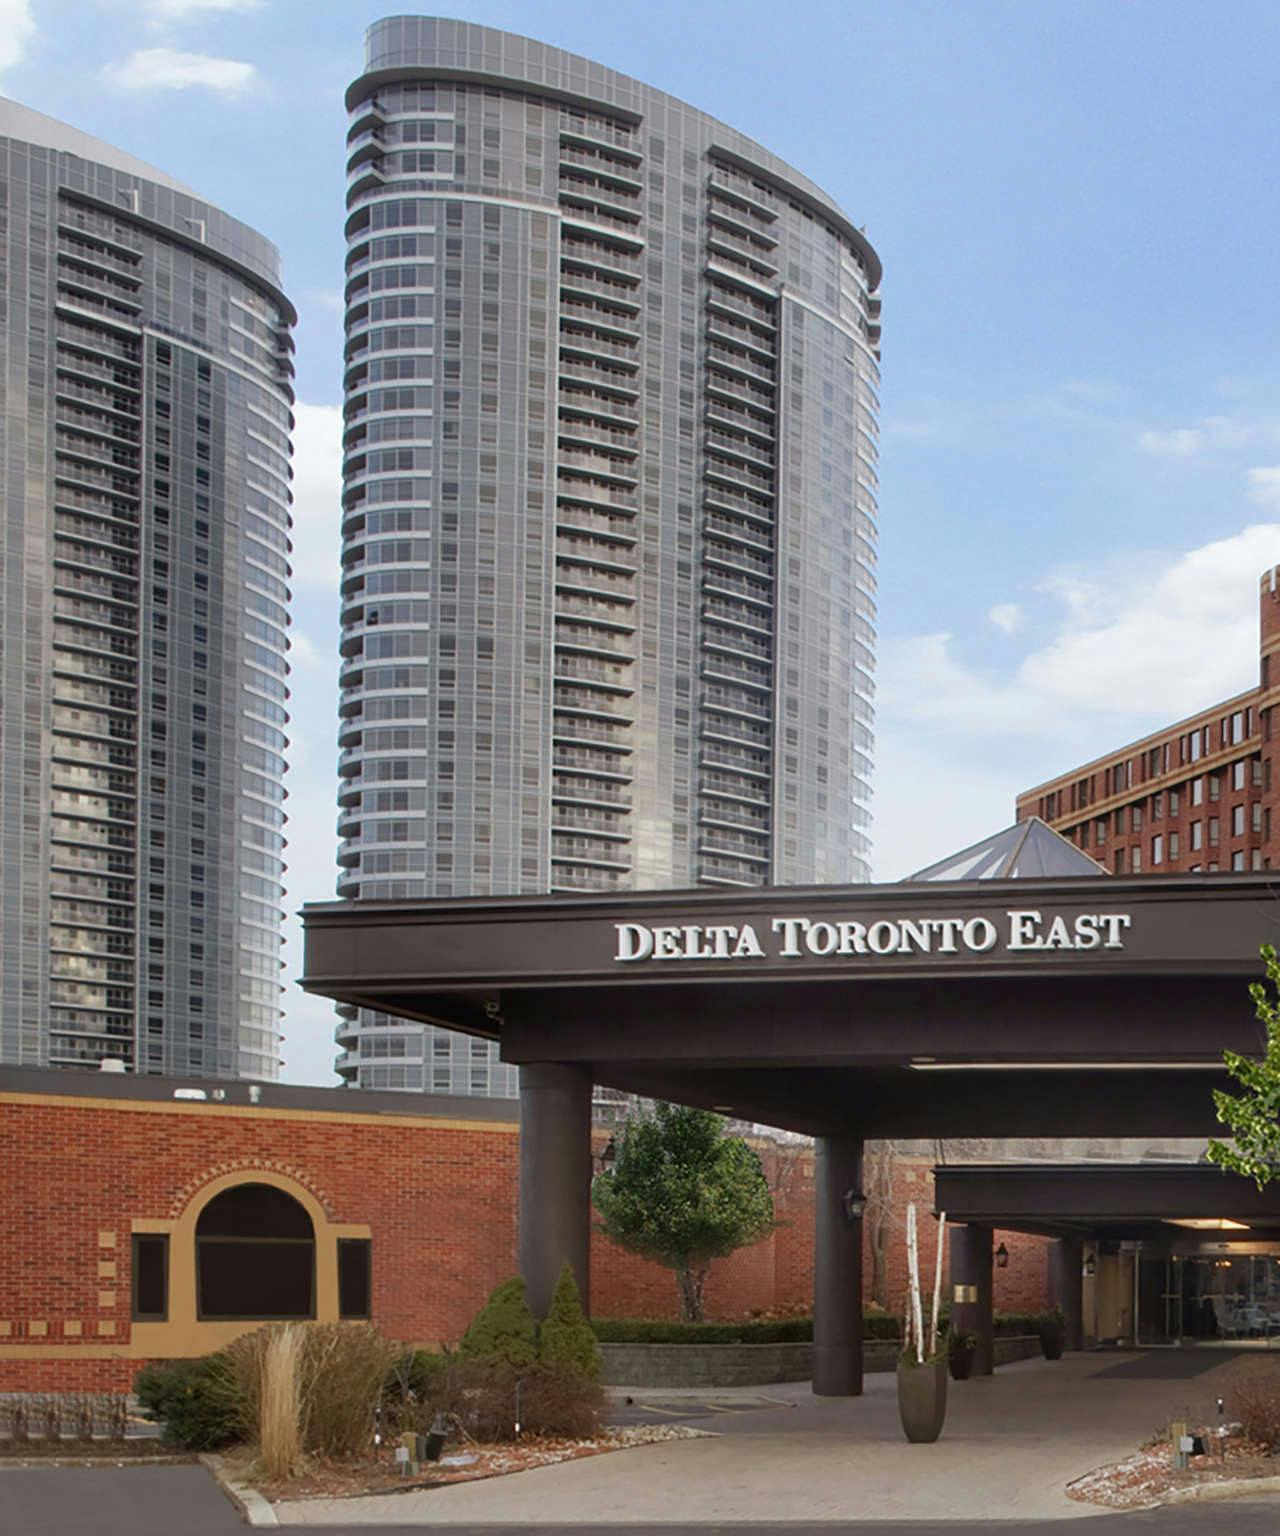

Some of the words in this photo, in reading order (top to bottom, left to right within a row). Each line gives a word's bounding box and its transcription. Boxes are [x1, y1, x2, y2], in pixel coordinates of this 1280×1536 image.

[614, 923, 766, 961] DELTA
[772, 917, 997, 956] TORONTO
[1006, 911, 1131, 950] EAST
